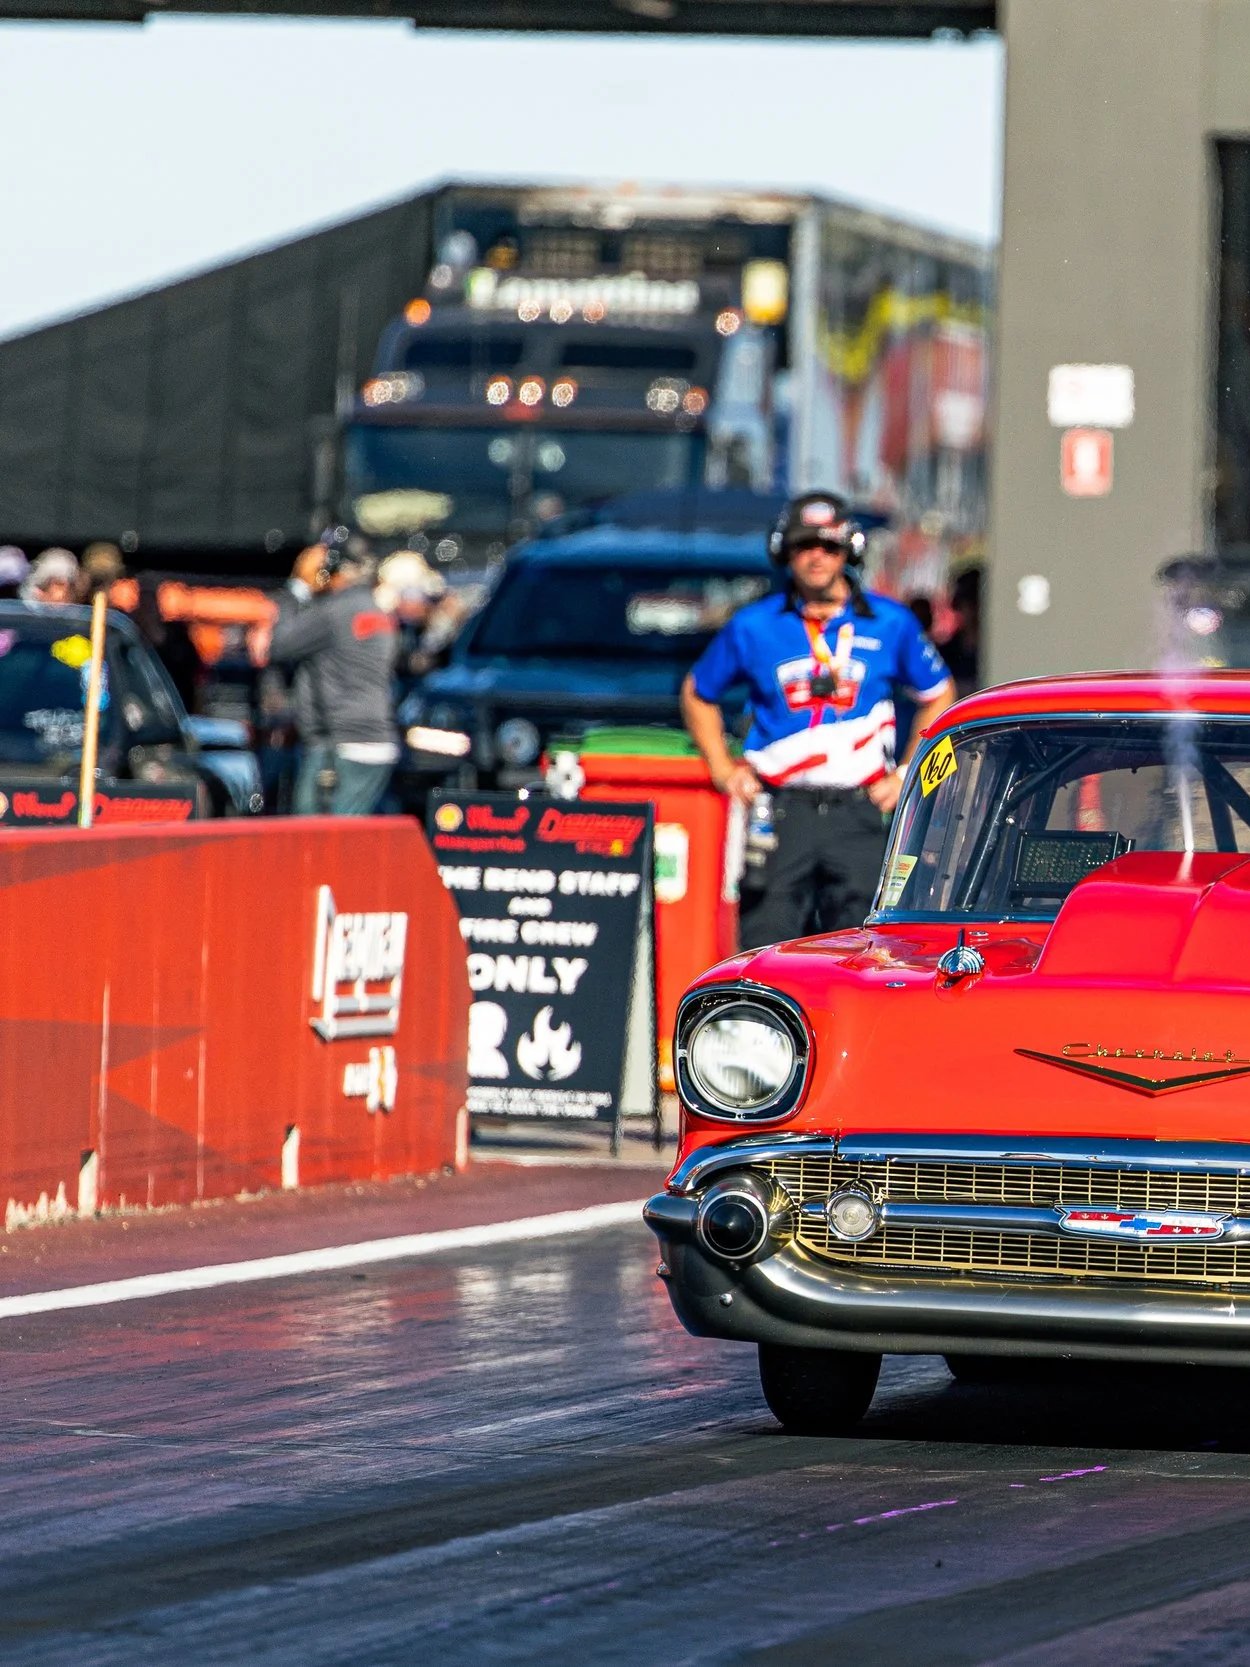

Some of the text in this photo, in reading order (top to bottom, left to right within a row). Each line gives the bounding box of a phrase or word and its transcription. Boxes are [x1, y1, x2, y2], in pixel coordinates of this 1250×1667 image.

[558, 870, 640, 897] STAFF
[520, 920, 599, 946] CREW
[466, 953, 589, 995] ONLY
